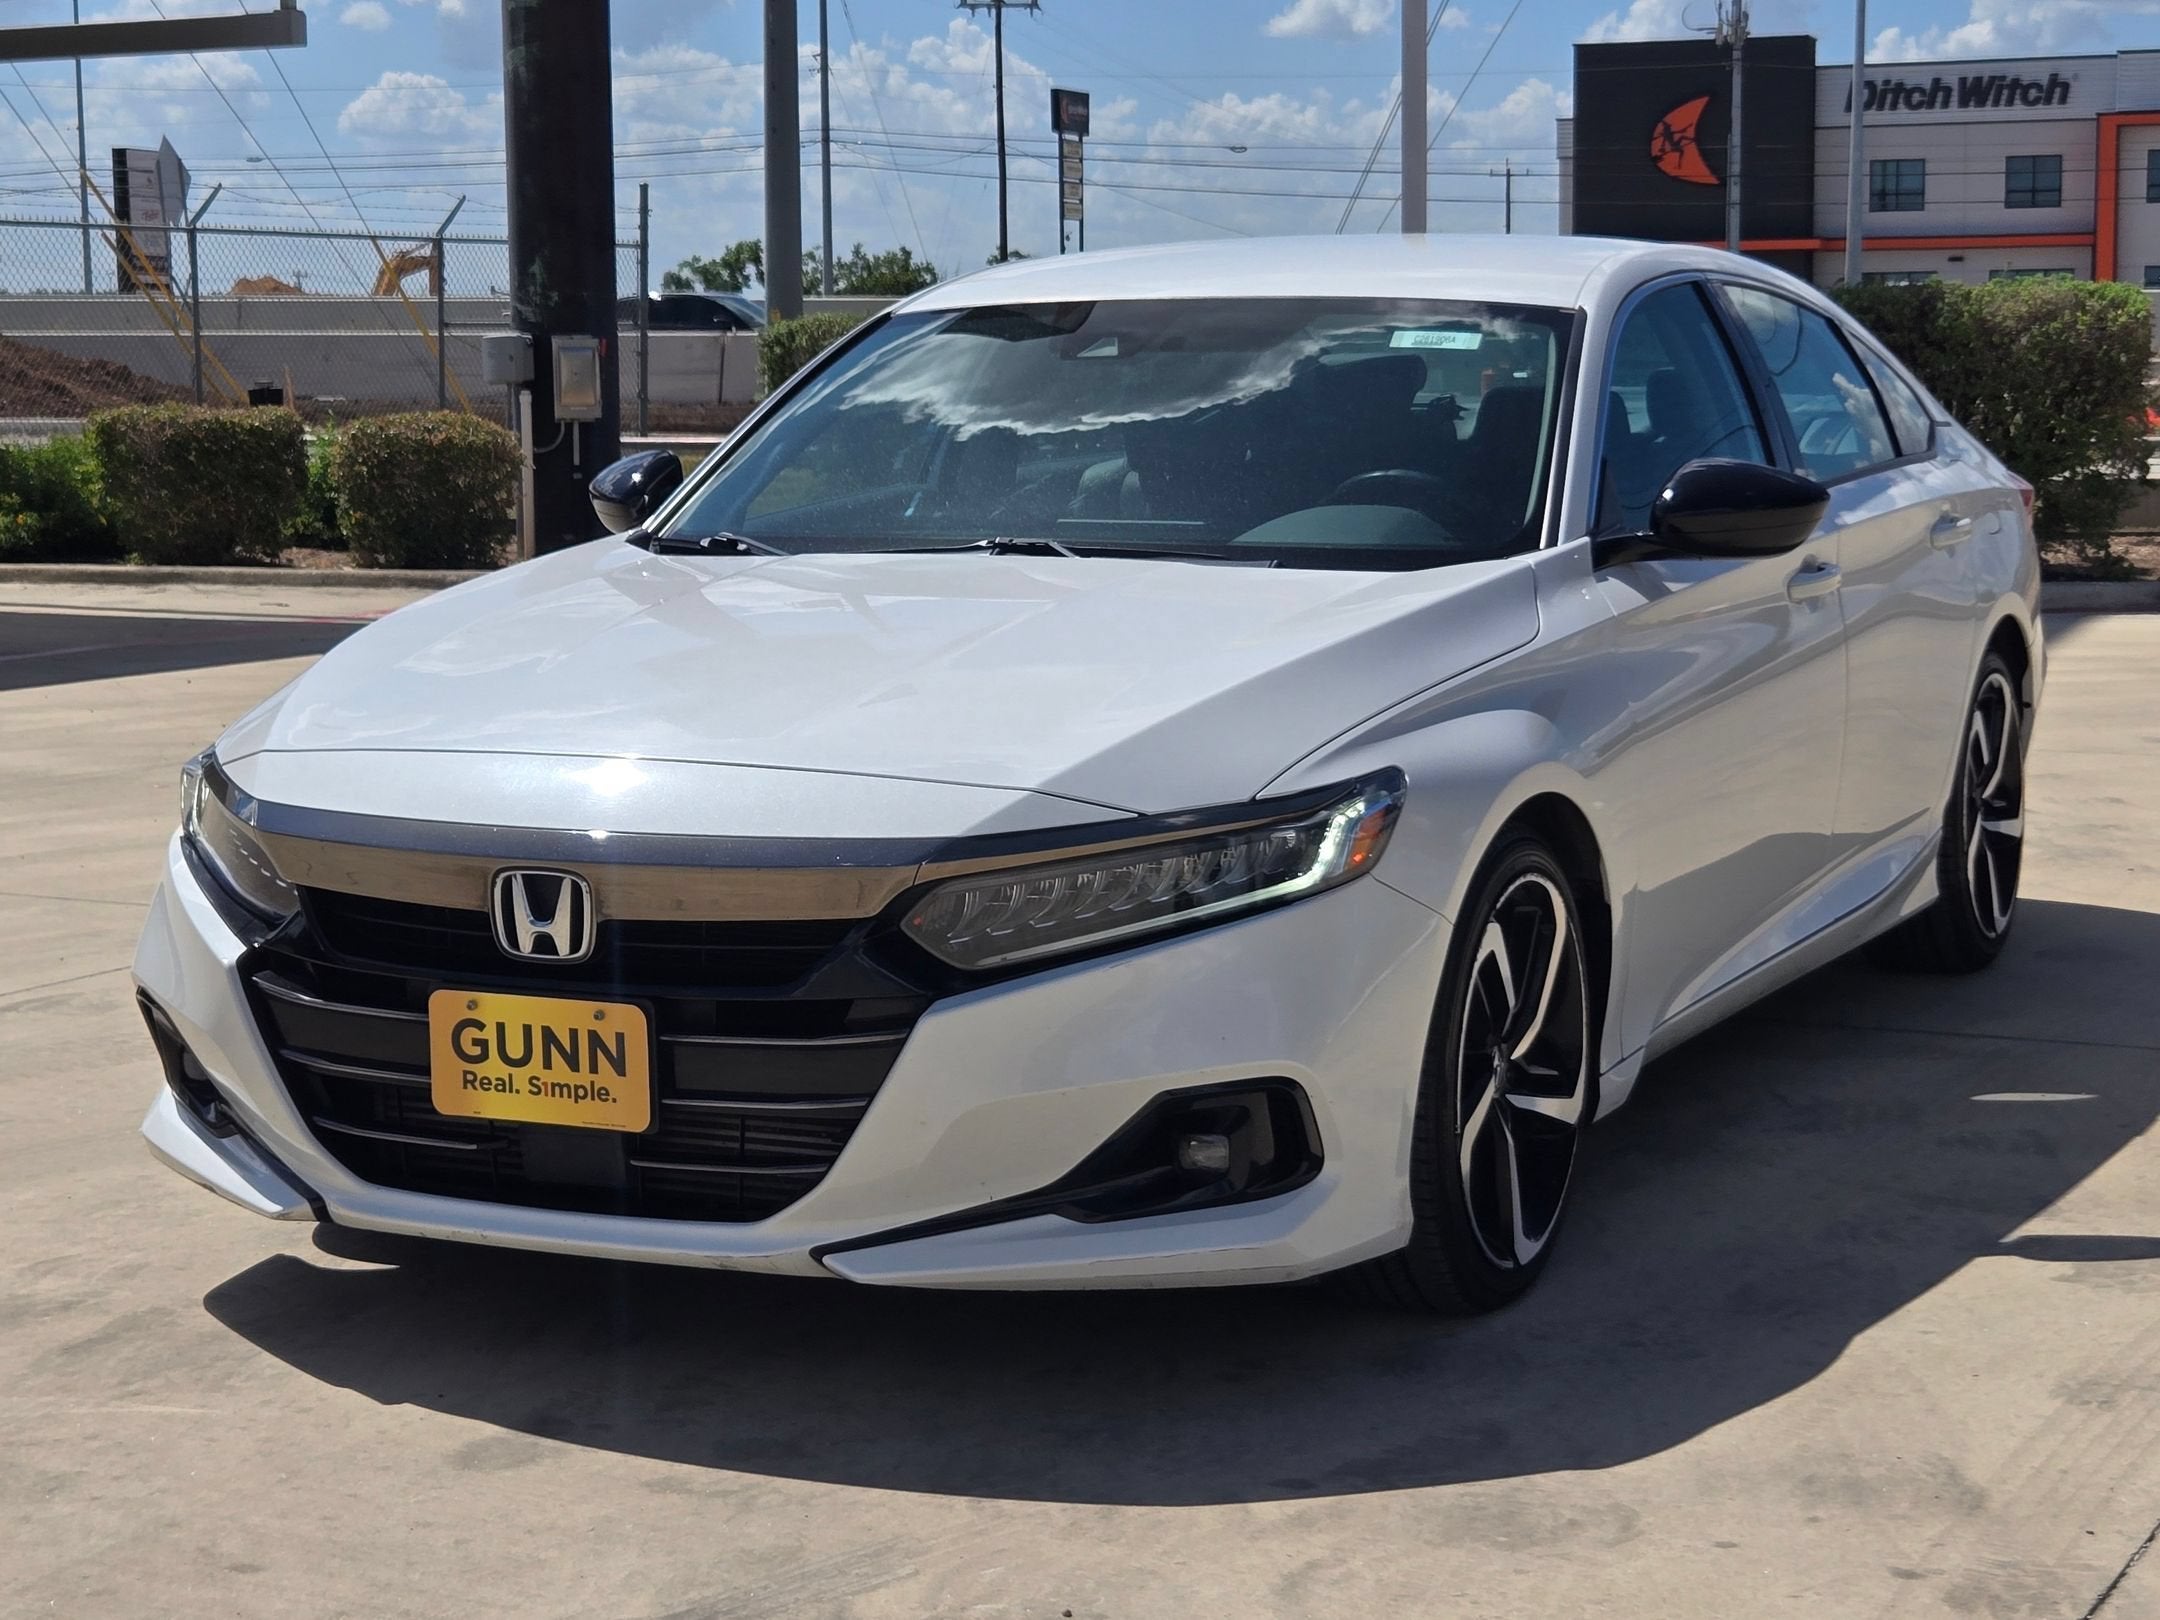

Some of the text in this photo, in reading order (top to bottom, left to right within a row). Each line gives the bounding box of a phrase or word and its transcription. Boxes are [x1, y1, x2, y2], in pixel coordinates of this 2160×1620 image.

[1843, 73, 2071, 112] Ditch Witch
[451, 1017, 627, 1077] GUNN
[462, 1069, 520, 1094] Real.
